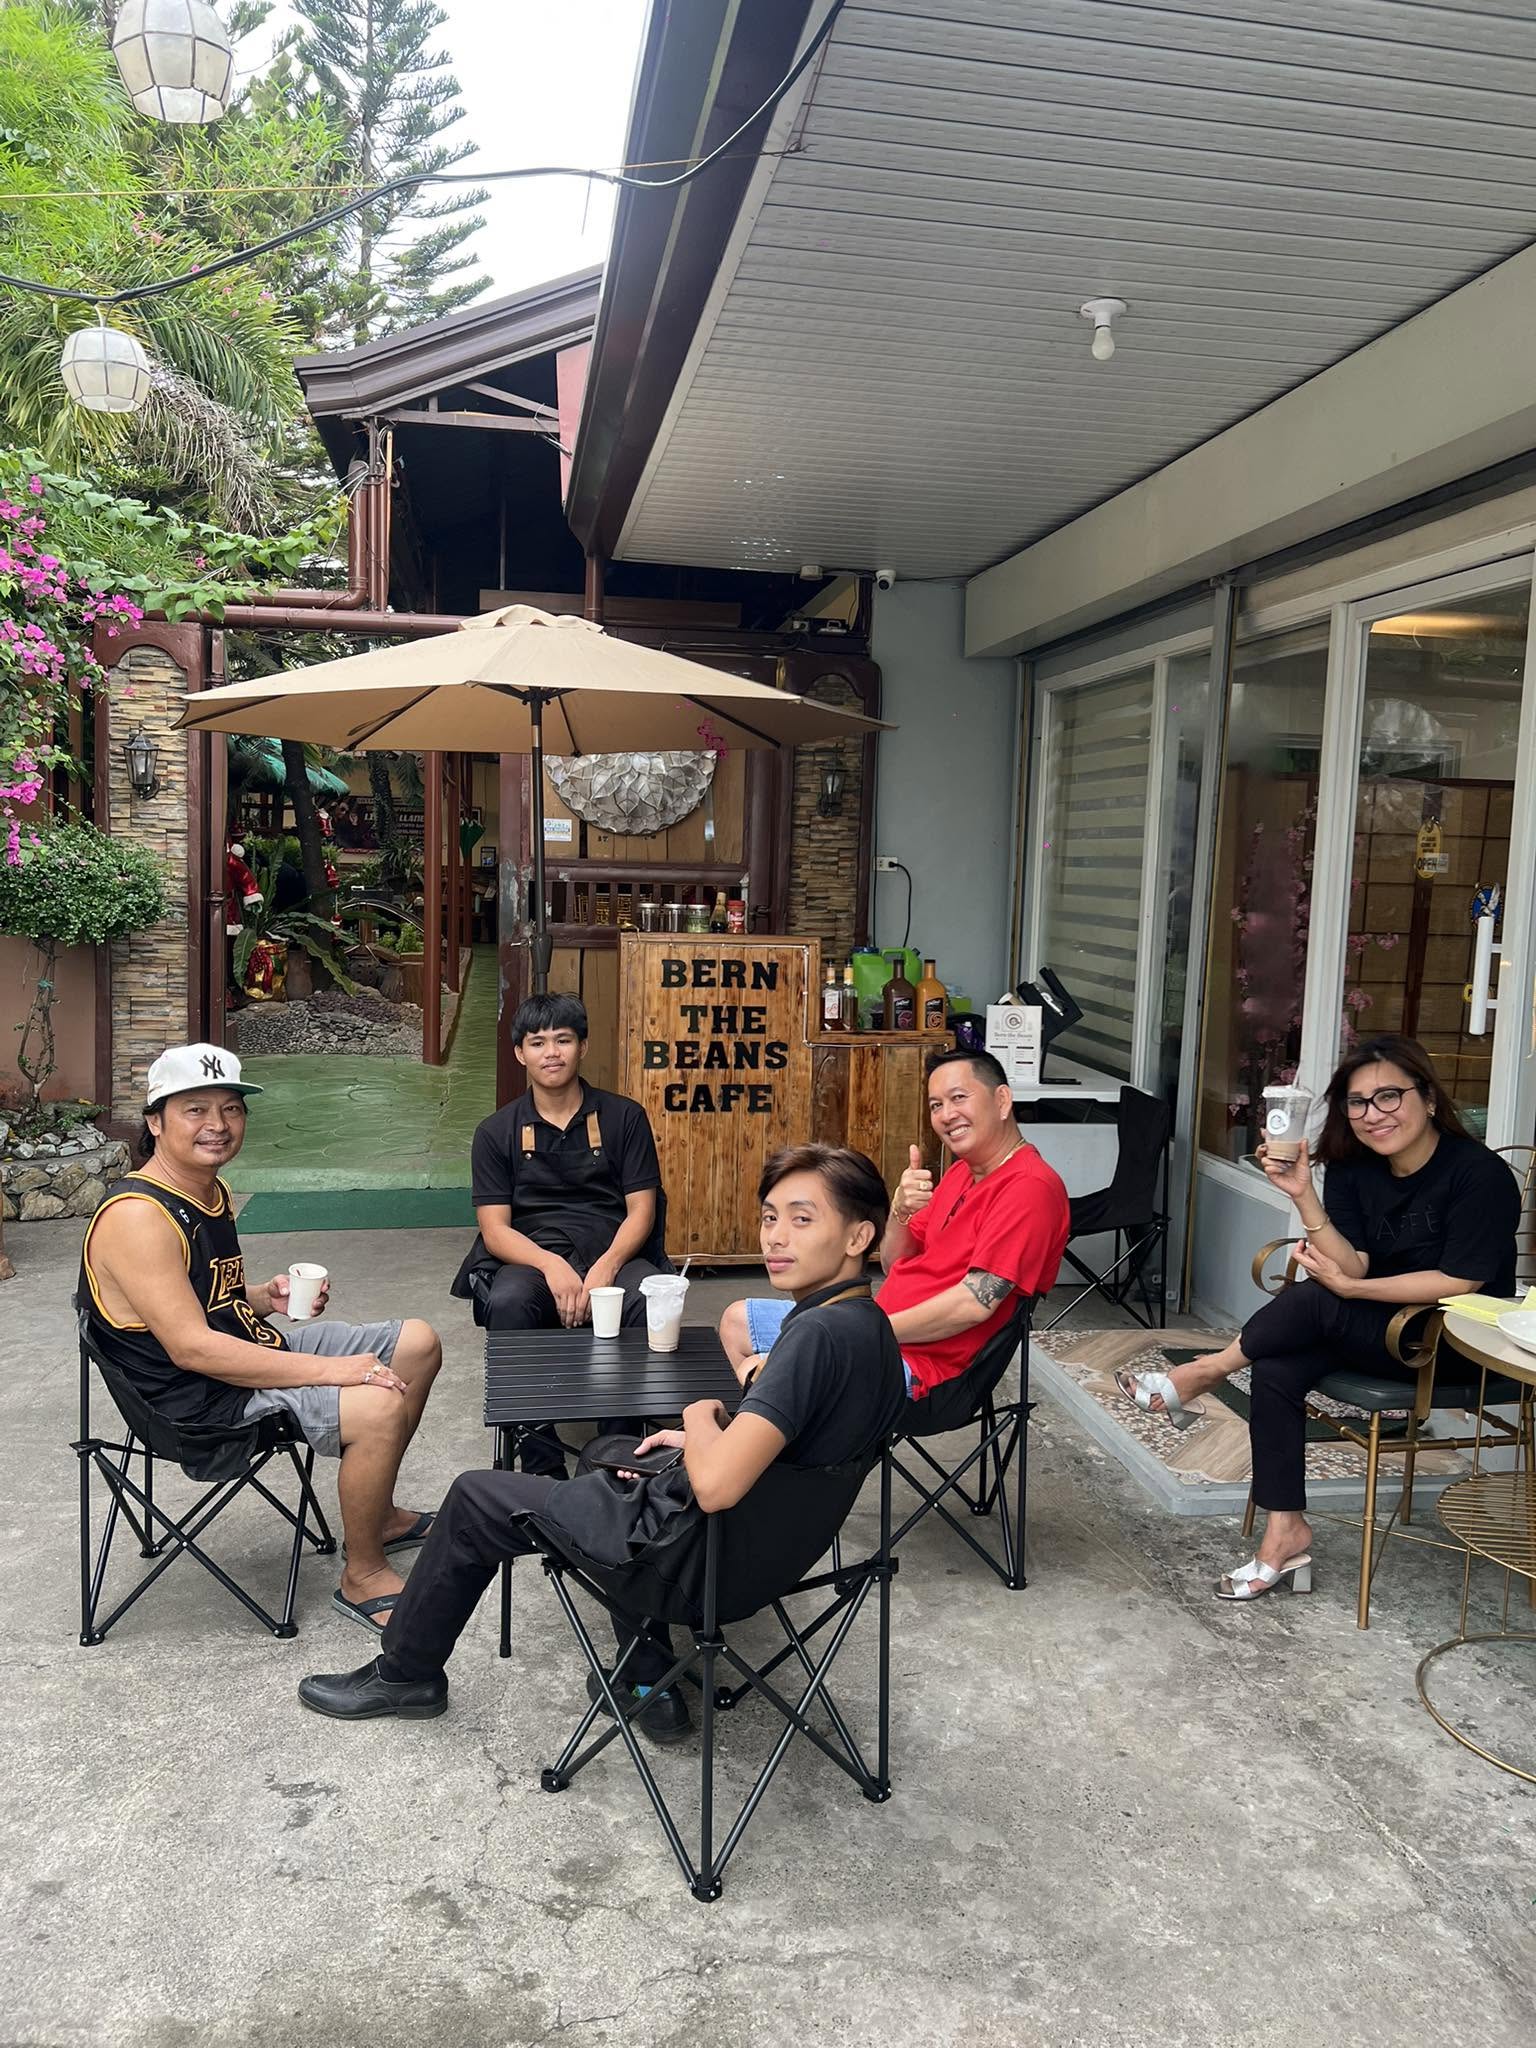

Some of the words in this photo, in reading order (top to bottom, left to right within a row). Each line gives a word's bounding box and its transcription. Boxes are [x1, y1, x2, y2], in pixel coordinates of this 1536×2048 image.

[1417, 857, 1437, 870] OPEN
[661, 959, 779, 990] BERN
[680, 1004, 767, 1034] THE
[200, 1055, 225, 1079] NY
[643, 1040, 788, 1069] BEANS
[664, 1083, 773, 1113] CAFE
